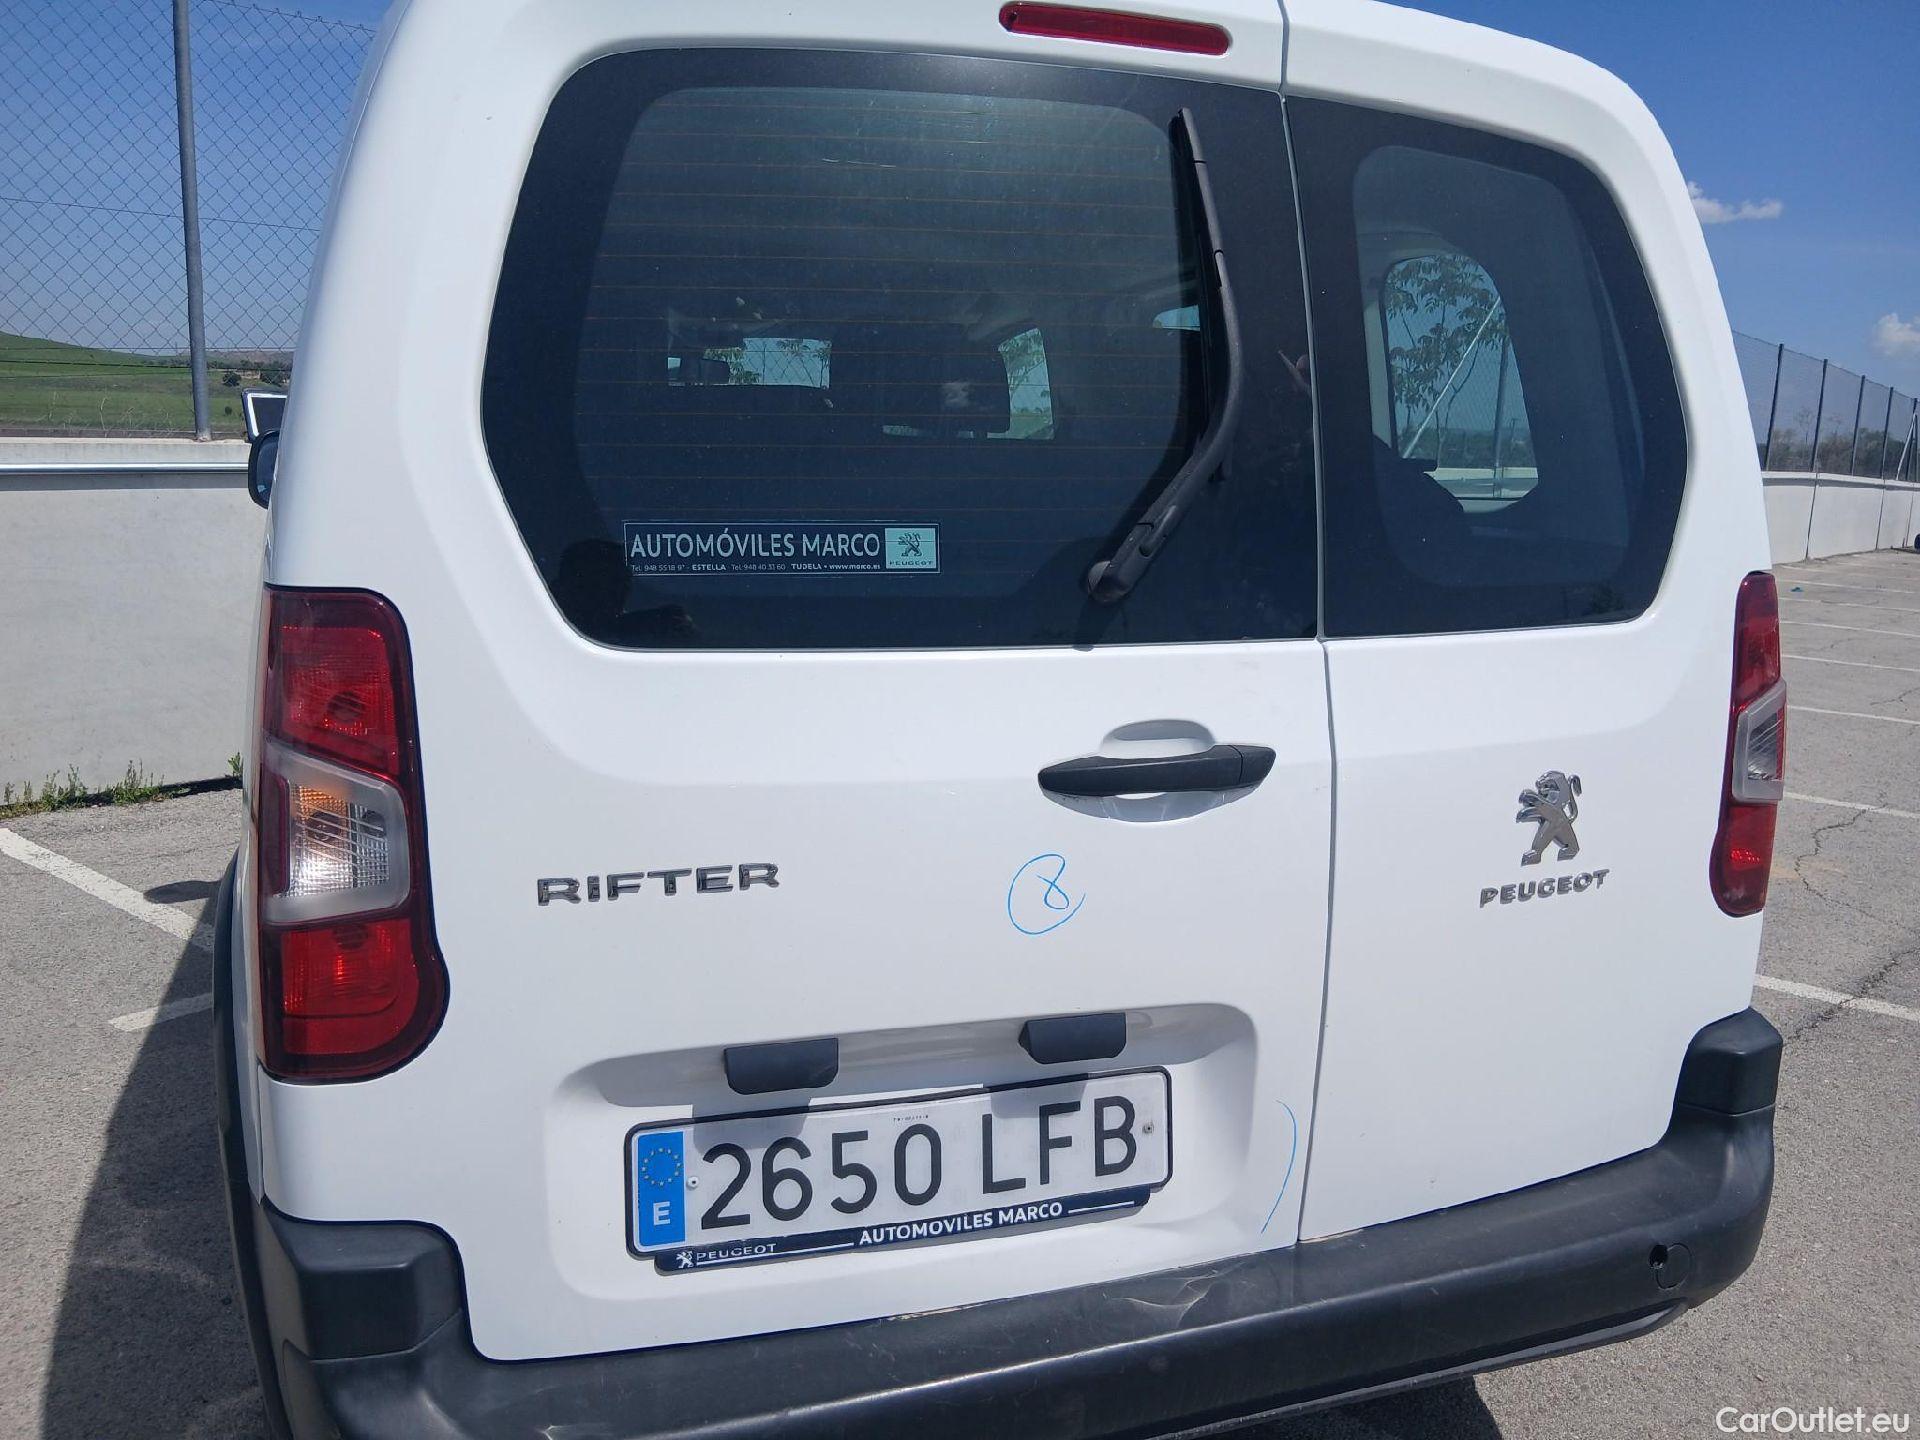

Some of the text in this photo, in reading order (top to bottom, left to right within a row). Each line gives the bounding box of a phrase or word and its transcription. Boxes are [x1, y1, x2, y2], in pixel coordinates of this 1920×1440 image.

[630, 527, 880, 558] AUTOMÓVILES MARCO
[692, 563, 727, 571] ESTELLA
[537, 862, 780, 907] RIFTER
[1479, 869, 1610, 909] PEUGEOT
[701, 1095, 1137, 1230] 2650 LFB
[653, 1201, 671, 1226] E
[859, 1202, 1063, 1246] AUTOMOVILES MARCO
[696, 1243, 777, 1261] PEUGEOT
